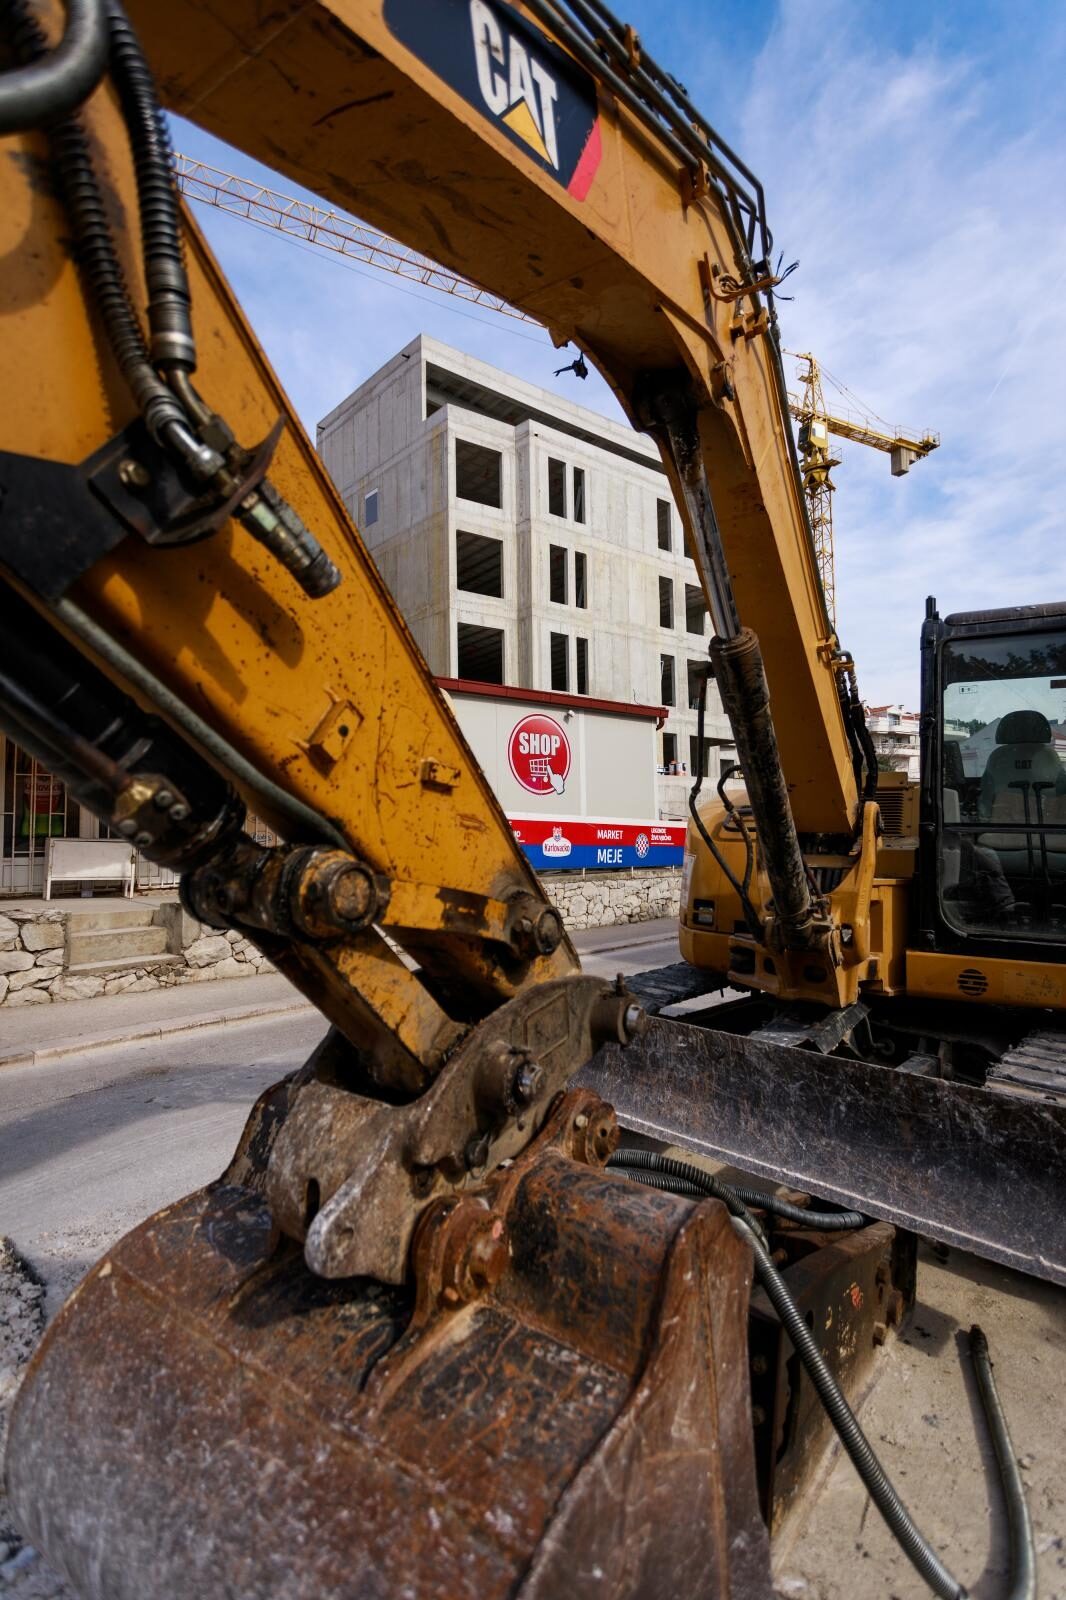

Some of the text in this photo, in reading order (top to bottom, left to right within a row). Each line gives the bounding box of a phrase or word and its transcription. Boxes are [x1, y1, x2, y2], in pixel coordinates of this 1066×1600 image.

[470, 0, 559, 171] CAT
[518, 731, 561, 756] SHOP
[597, 829, 624, 840] MARKET
[597, 848, 623, 864] MEJE
